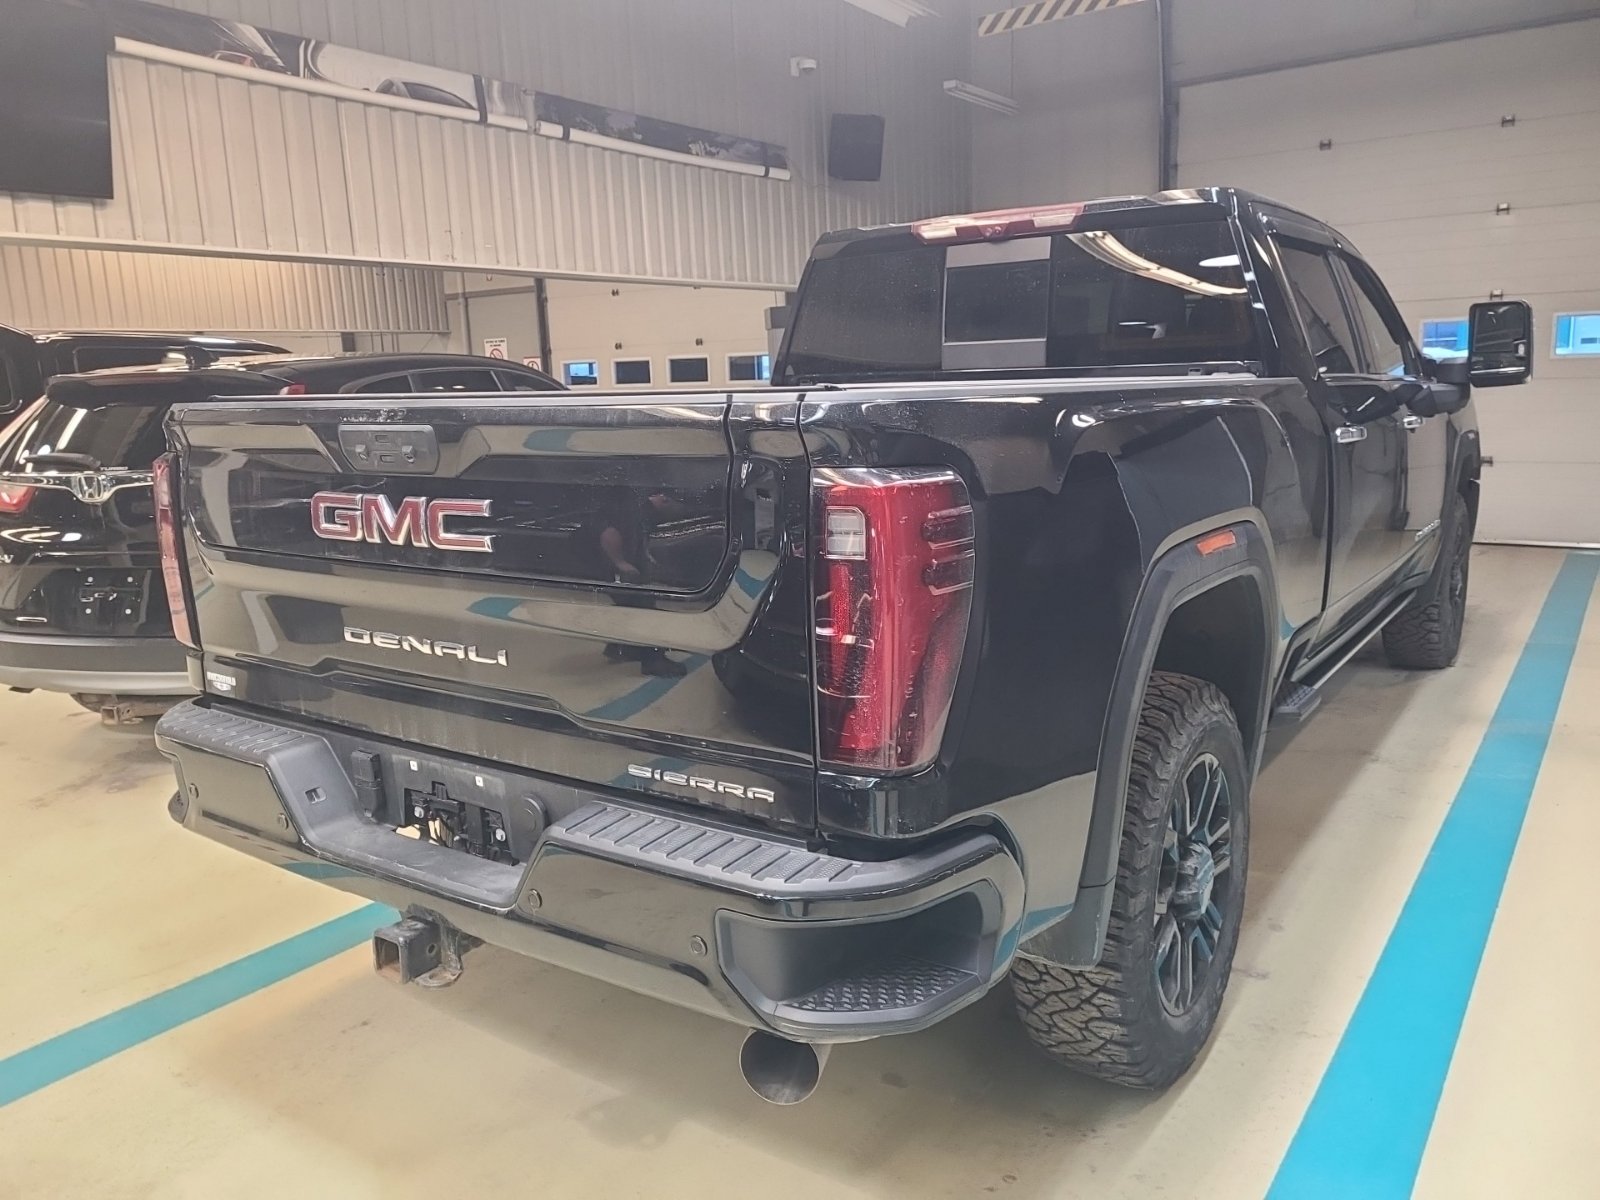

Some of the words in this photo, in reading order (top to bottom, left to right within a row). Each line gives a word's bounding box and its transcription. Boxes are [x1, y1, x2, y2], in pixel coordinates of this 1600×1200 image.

[311, 491, 493, 552] GMC
[343, 626, 508, 666] DENALI
[627, 763, 775, 803] SIERRA
